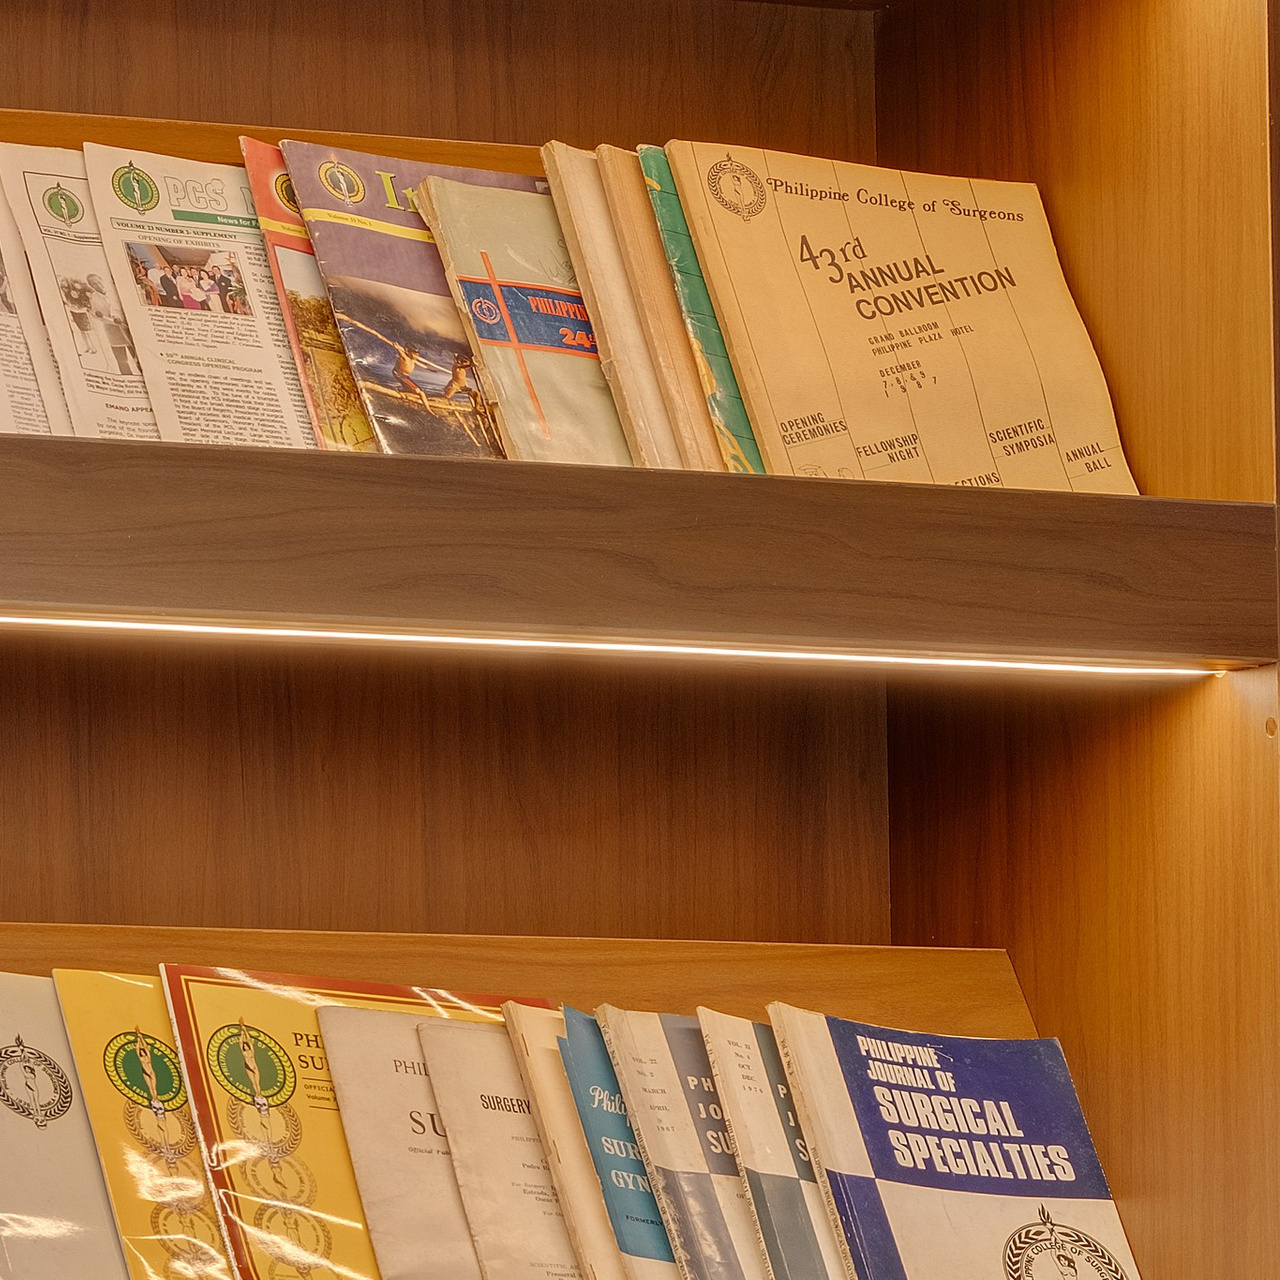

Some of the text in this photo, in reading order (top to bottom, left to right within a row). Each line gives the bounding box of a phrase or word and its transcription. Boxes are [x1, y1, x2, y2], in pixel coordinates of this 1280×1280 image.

[164, 176, 228, 211] PCS
[766, 177, 1024, 222] Philippine College of Surgeons
[116, 221, 147, 230] VOLUME
[155, 226, 185, 235] NUMBER
[192, 230, 237, 240] SUPPLEMENT
[138, 234, 220, 248] OPENING OF EXHIBITS
[799, 234, 867, 284] 43rd
[846, 254, 945, 293] ANNUAL
[855, 266, 1017, 320] CONVENTION
[868, 321, 940, 345] GRAND BALLROOM
[871, 324, 974, 357] PHILIPPINE PLAZA HOTEL
[879, 360, 922, 378] DECEMBER
[780, 412, 826, 433] OPENING
[783, 419, 848, 446] CEREMONIES
[988, 418, 1046, 444] SCIENTIFIC
[855, 433, 919, 458] FELLOWSHIP
[887, 447, 921, 464] NIGHT
[1002, 433, 1056, 458] SYMPOSIA
[1065, 441, 1105, 463] ANNUAL
[1085, 457, 1113, 474] BALL
[856, 1034, 941, 1068] PHILIPPINE
[867, 1059, 956, 1092] JOURNAL OF
[479, 1093, 533, 1116] SURGERY
[873, 1085, 1024, 1137] SURGICAL
[888, 1129, 1076, 1181] SPECIALTIES
[625, 1214, 664, 1227] FORMERLY
[1032, 1242, 1067, 1255] COLLEGE
[1069, 1245, 1084, 1257] OF
